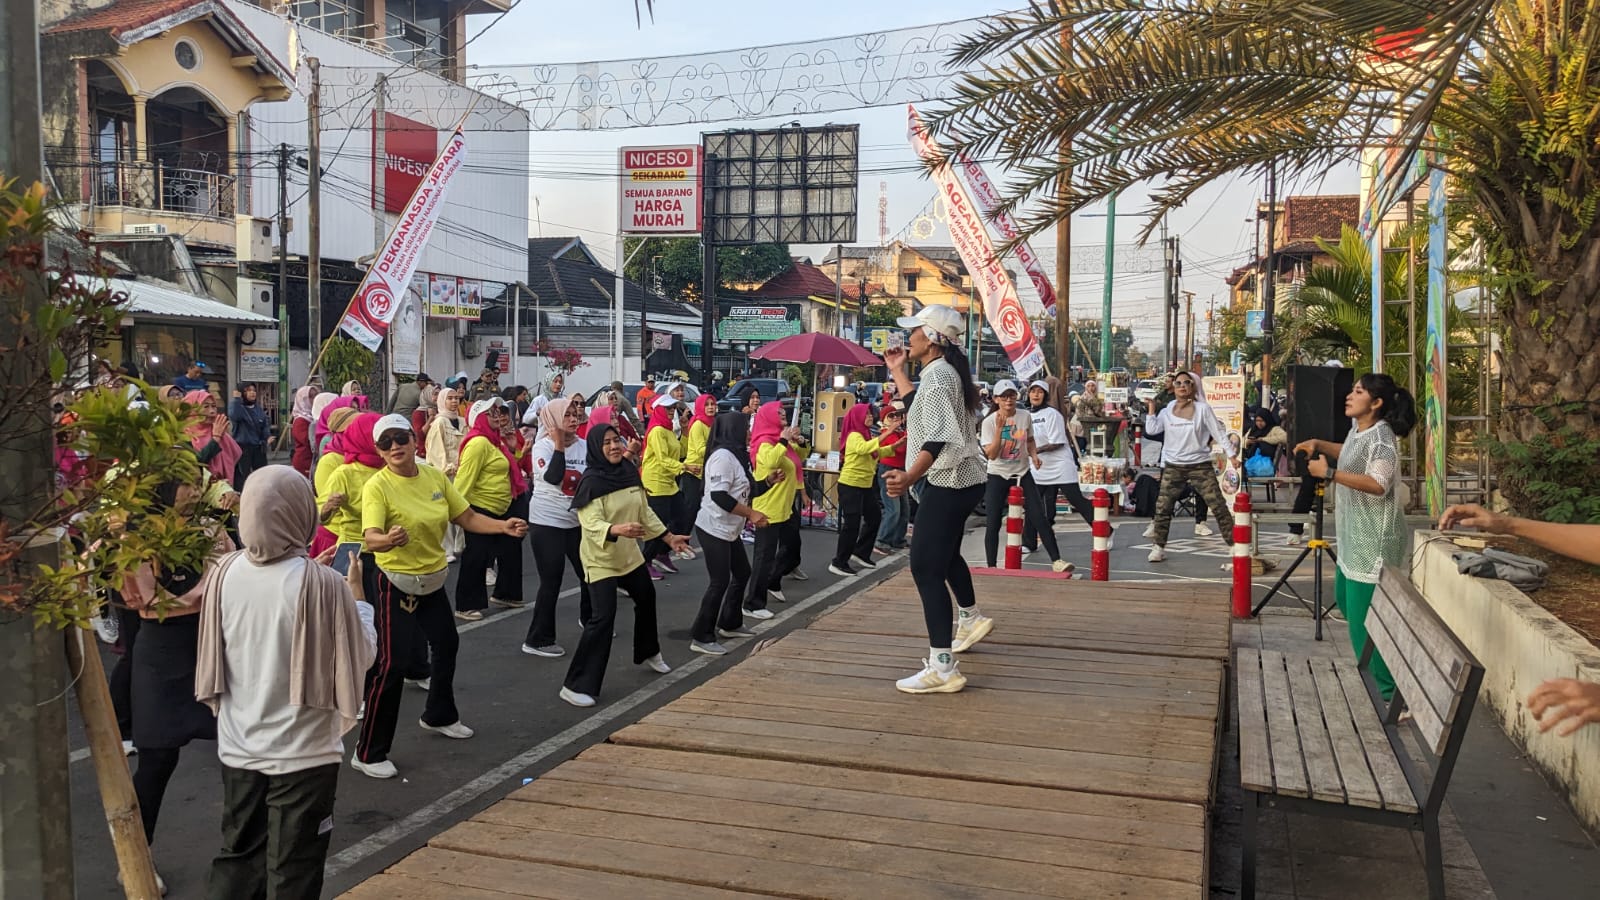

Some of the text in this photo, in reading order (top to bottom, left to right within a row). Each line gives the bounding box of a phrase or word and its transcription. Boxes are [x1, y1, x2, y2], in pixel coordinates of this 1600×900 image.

[630, 151, 688, 167] NICESO
[632, 170, 686, 180] SEKARANG
[625, 188, 693, 198] SEMUA BARANG
[379, 139, 464, 273] DEKRANASDA JEPARA
[635, 199, 682, 212] HARGA
[633, 213, 684, 227] MURAH
[390, 253, 406, 278] DEWAN
[424, 185, 444, 218] NASIONAL
[418, 220, 433, 245] JEPARA
[1214, 382, 1233, 390] FACE
[1207, 392, 1241, 401] PAINTING
